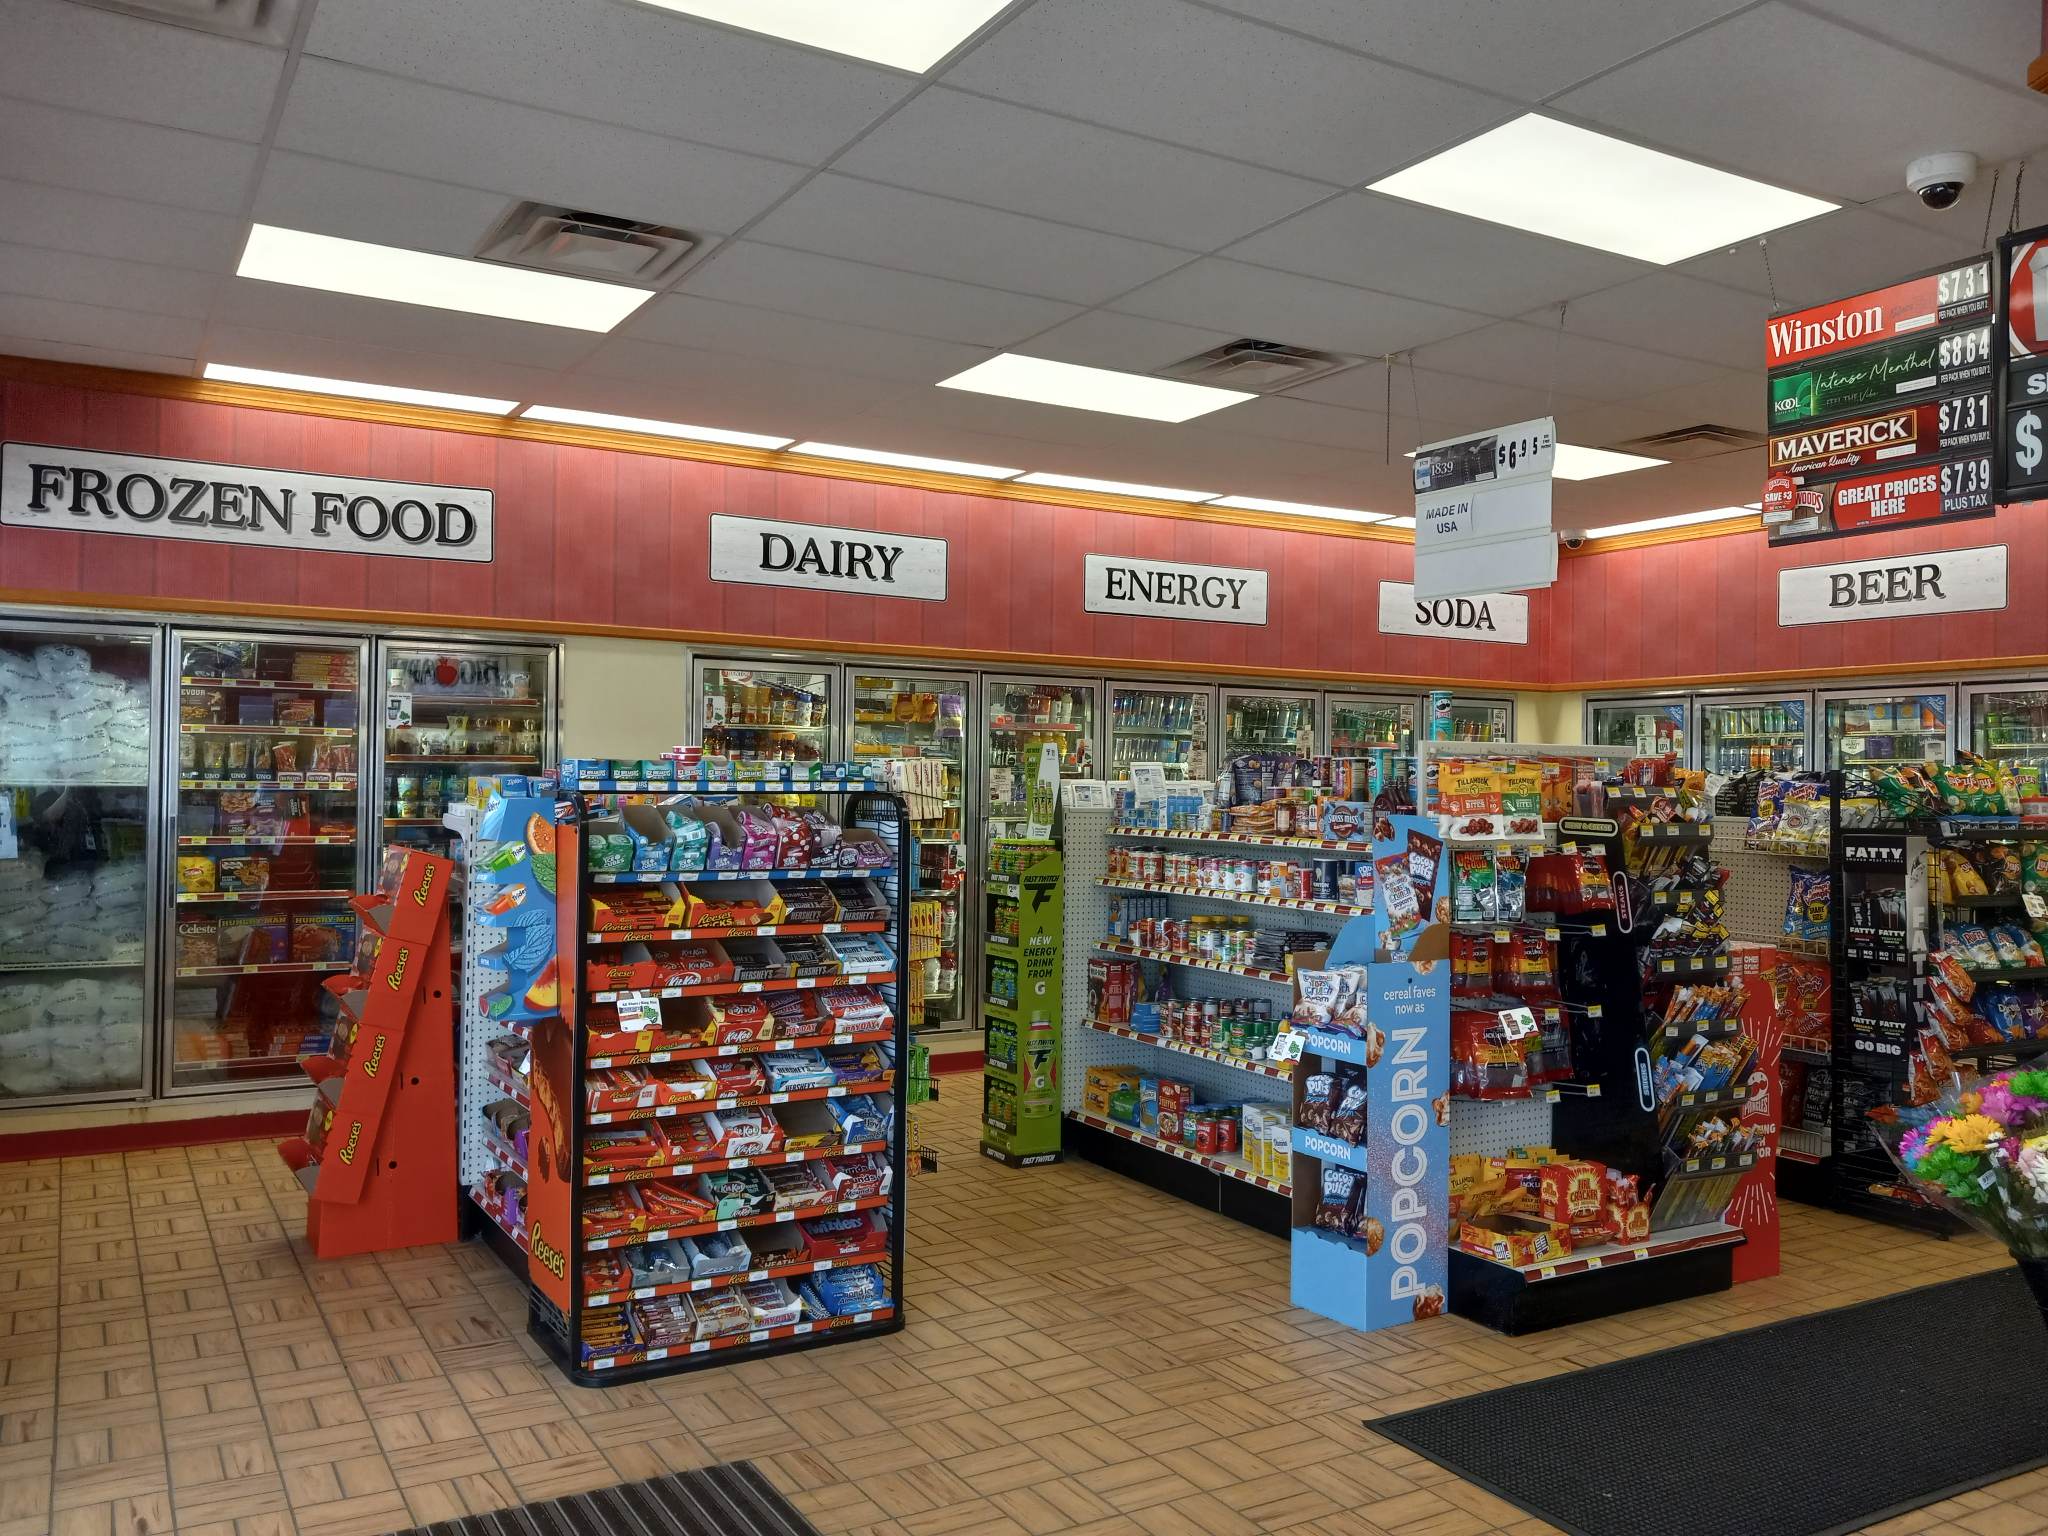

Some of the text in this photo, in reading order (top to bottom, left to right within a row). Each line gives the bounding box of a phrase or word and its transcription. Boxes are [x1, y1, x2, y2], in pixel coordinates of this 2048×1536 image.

[1939, 262, 1989, 304] $7.31
[1768, 306, 1885, 358] Winston
[1939, 327, 1990, 369] $8.64
[1869, 348, 1936, 381] Menthol
[1774, 397, 1801, 412] KOOL
[1939, 395, 1989, 434] $7.31
[1777, 416, 1910, 462] MAVERICK
[2015, 409, 2043, 475] $
[1432, 461, 1454, 476] 1839
[1786, 454, 1862, 475] American Quality
[1940, 458, 1990, 496] $7.39
[1764, 490, 1793, 503] SAVE $3
[1838, 474, 1938, 506] GREAT PRICES
[27, 463, 475, 547] FROZEN FOOD
[1870, 498, 1906, 518] HERE
[1944, 493, 1988, 512] PLUS TAX
[1425, 502, 1469, 520] MADE IN
[1437, 520, 1458, 534] USA
[759, 532, 904, 582] DAIRY
[1105, 567, 1247, 609] ENERGY
[1828, 563, 1946, 608] BEER
[1415, 598, 1497, 631] SODA
[1456, 777, 1489, 787] TILLAMOOK
[1508, 778, 1536, 788] TILLAMOOK
[1466, 801, 1486, 810] BITES
[1846, 847, 1903, 858] FATTY
[1409, 852, 1434, 869] Cocoa
[1409, 864, 1433, 880] Puffs
[413, 864, 435, 907] Reese's
[791, 911, 821, 920] HERSHEY'S
[845, 911, 875, 920] HERSHEY'S
[179, 923, 217, 935] Celeste
[1037, 926, 1043, 934] A
[1878, 929, 1905, 937] FATTY
[624, 932, 653, 942] Reese's
[1029, 935, 1052, 946] NEW
[1023, 947, 1057, 957] ENERGY
[387, 948, 409, 991] Reese's
[1026, 958, 1054, 968] DRINK
[607, 969, 635, 978] Reese's
[741, 970, 773, 980] HERSHEY'S
[1027, 968, 1053, 978] FROM
[1384, 986, 1436, 1000] cereal faves
[1395, 1003, 1425, 1015] now as
[843, 1020, 880, 1032] PAYDAY
[1851, 1017, 1876, 1026] FATTY
[1879, 1020, 1906, 1029] FATTY
[786, 1023, 817, 1036] PAYDAY
[1306, 1031, 1350, 1055] POPCORN
[1855, 1040, 1901, 1055] GO BIG
[364, 1034, 386, 1078] Reese's
[785, 1082, 816, 1091] HERSHEY'S
[1640, 1063, 1649, 1096] STICKS
[668, 1095, 693, 1104] Reese's
[1744, 1098, 1768, 1115] PRINGLES
[339, 1121, 362, 1165] Reese's
[1305, 1136, 1350, 1160] POPCORN
[1022, 1154, 1056, 1165] FAST TWITCH
[1391, 1027, 1428, 1300] POPCORN
[625, 1170, 654, 1180] Reese's
[1324, 1169, 1354, 1184] Cocoa
[845, 1188, 875, 1199] Mounds
[1324, 1180, 1351, 1197] Puffs
[531, 1221, 567, 1280] Reese's
